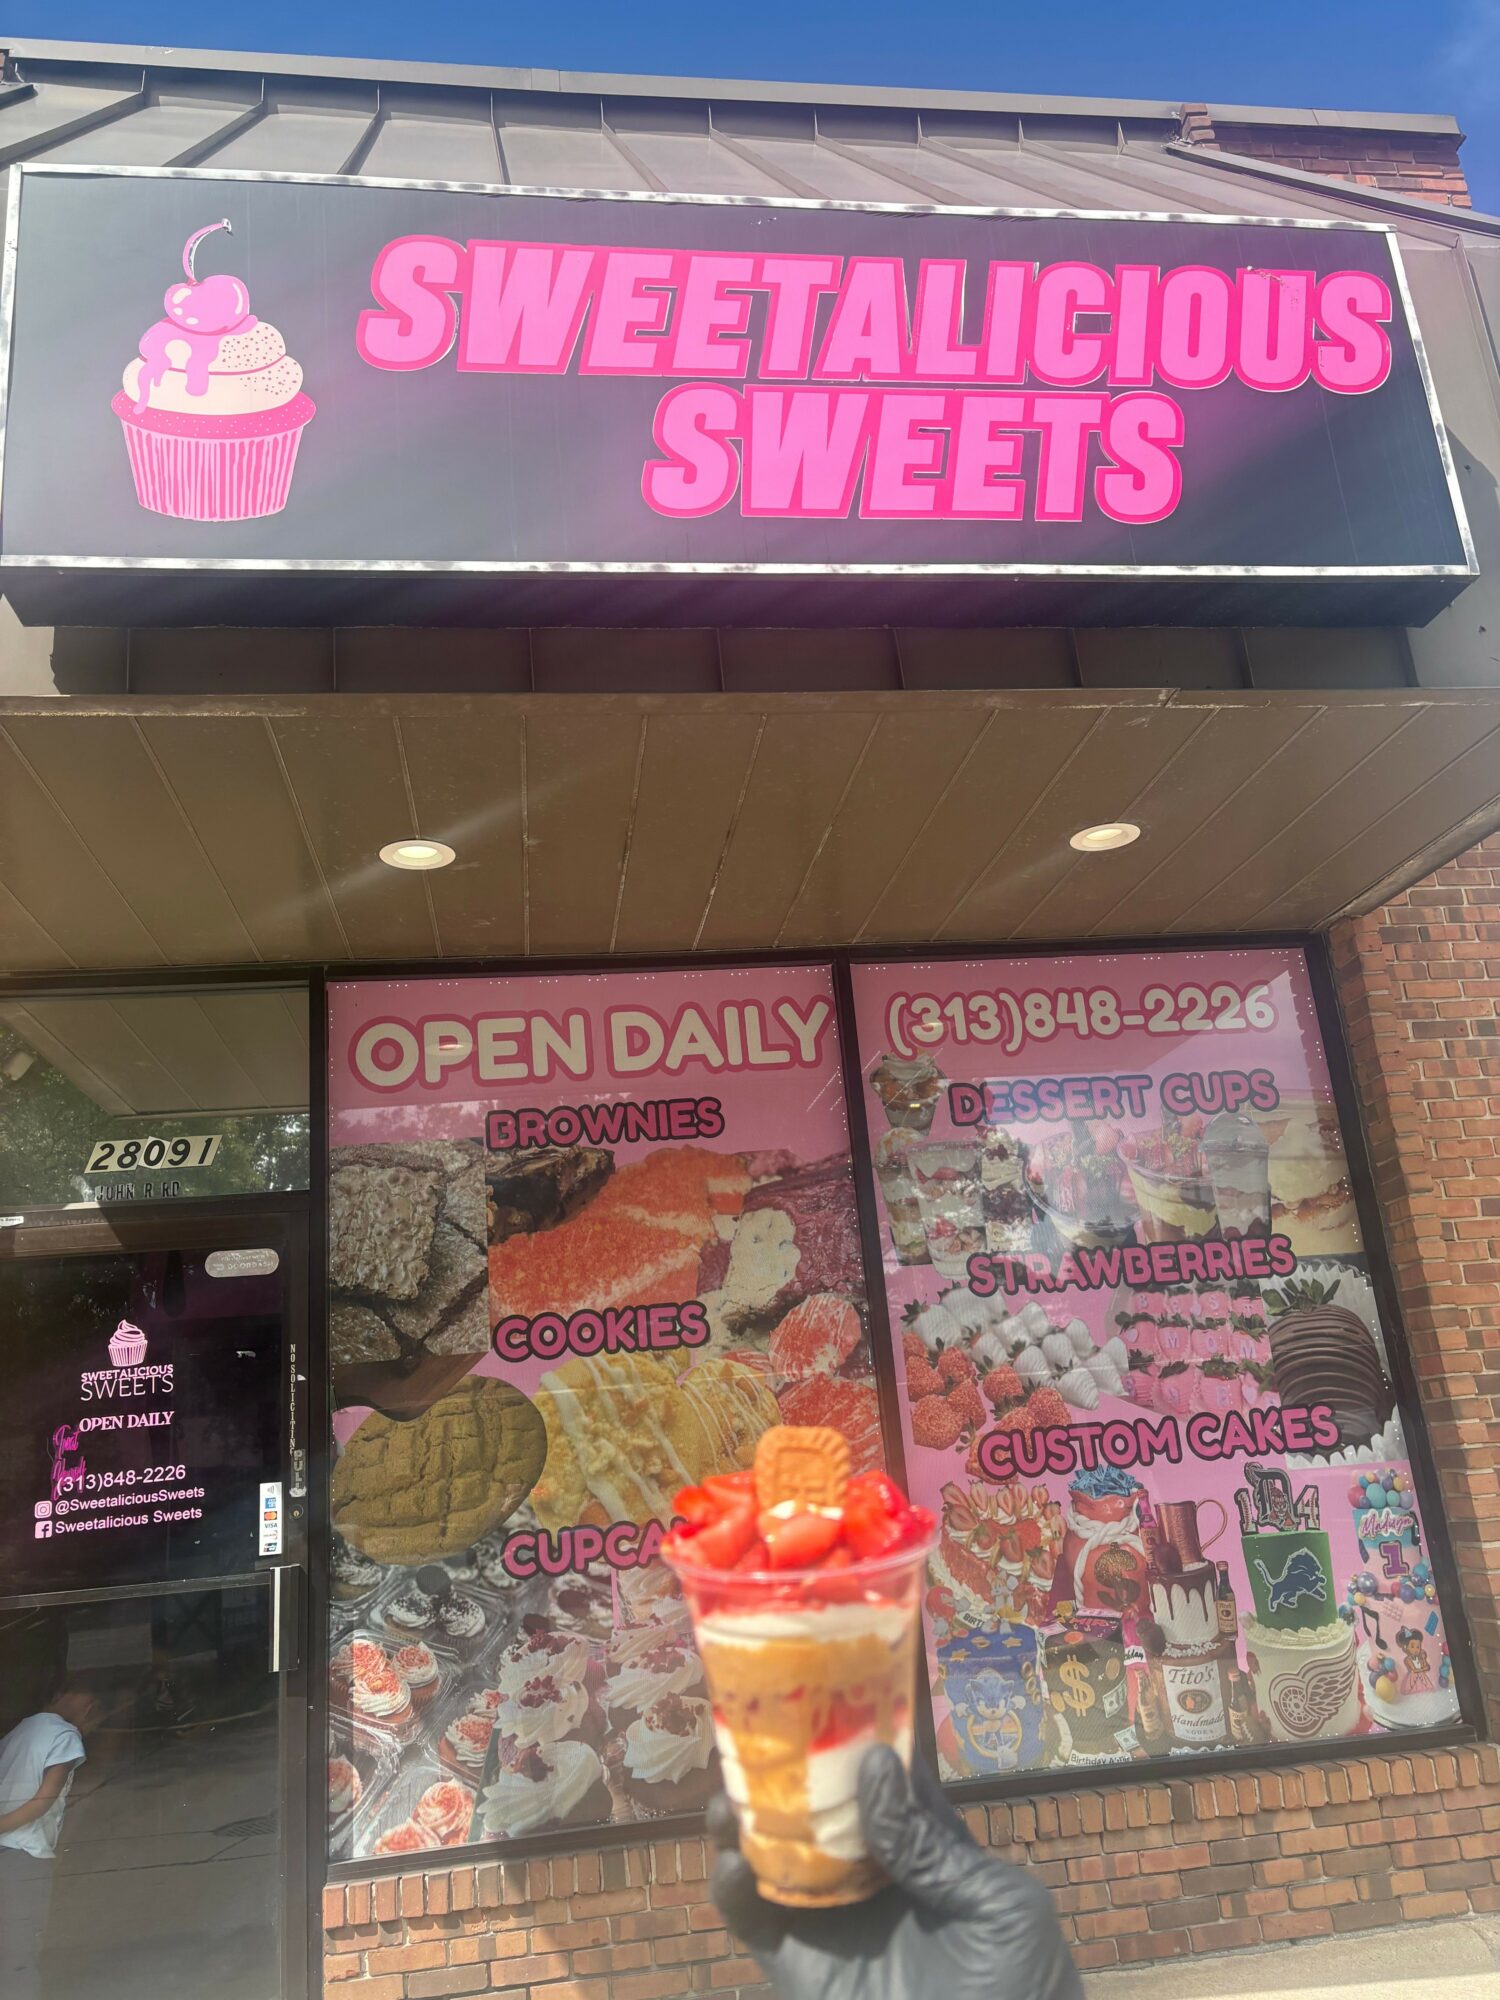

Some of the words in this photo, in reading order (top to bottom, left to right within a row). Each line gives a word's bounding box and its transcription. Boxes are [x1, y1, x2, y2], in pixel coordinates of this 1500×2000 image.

[356, 234, 1394, 394] SWEETALICIOUS
[641, 382, 1185, 524] SWEETS
[348, 1007, 592, 1093] OPEN
[605, 995, 837, 1077] DAILY
[884, 980, 1281, 1060] (313)848-2226
[485, 1097, 725, 1151] BROWNIES
[948, 1073, 1152, 1126] DESSERT
[1160, 1068, 1281, 1115] CUPS
[90, 1137, 214, 1171] 28091
[966, 1233, 1297, 1298] STRAWBERRIES
[493, 1301, 711, 1363] COOKIES
[80, 1363, 174, 1382] SWEETALICIOUS
[80, 1373, 174, 1402] SWEETS
[79, 1414, 125, 1432] OPEN
[127, 1411, 175, 1429] DAILY
[978, 1415, 1181, 1479] CUSTOM
[1187, 1403, 1340, 1460] CAKES
[55, 1486, 205, 1516] @SweetaliciousSweets
[56, 1464, 187, 1496] (313)848-2226
[55, 1513, 149, 1534] Sweetalicious
[153, 1507, 203, 1523] Sweets
[502, 1516, 688, 1580] CUPCA
